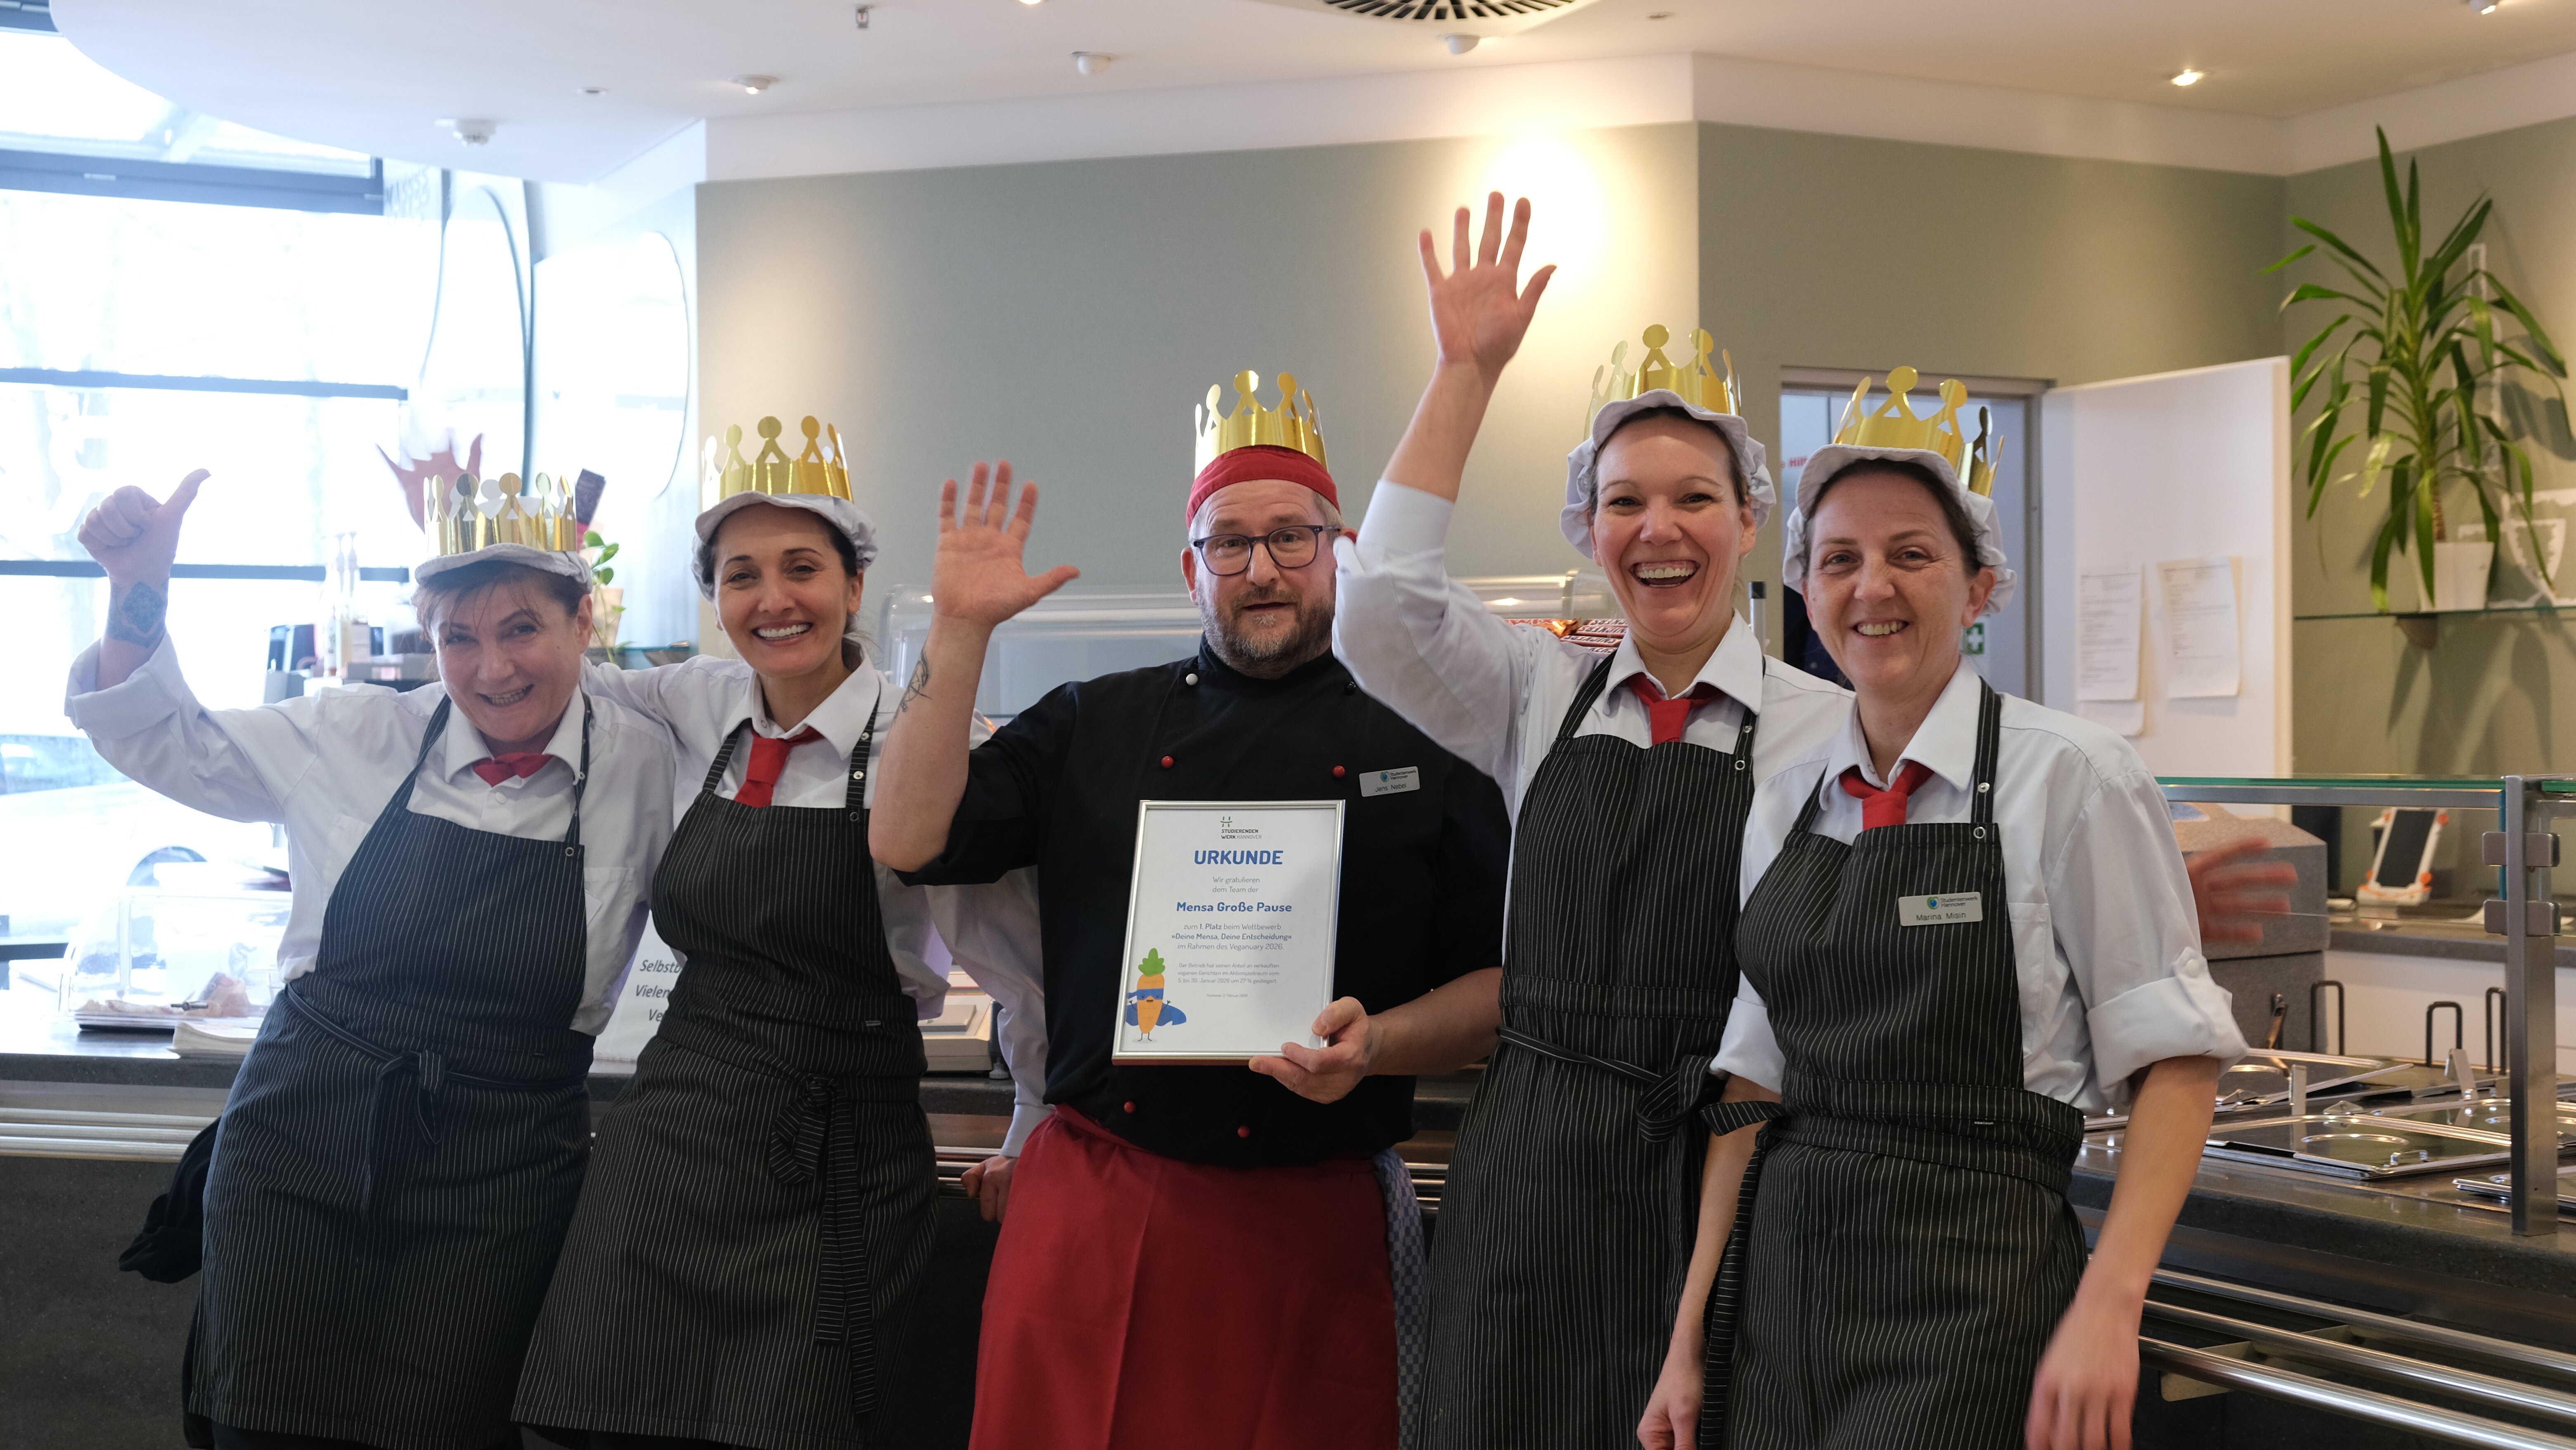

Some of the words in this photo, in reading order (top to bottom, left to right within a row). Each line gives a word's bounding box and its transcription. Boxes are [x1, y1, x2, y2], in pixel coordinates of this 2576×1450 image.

[1194, 850, 1283, 865] URKUNDE
[1177, 902, 1214, 912] Mensa
[1217, 902, 1253, 912] Große
[1257, 902, 1292, 912] Pause
[639, 959, 682, 973] Selbstb
